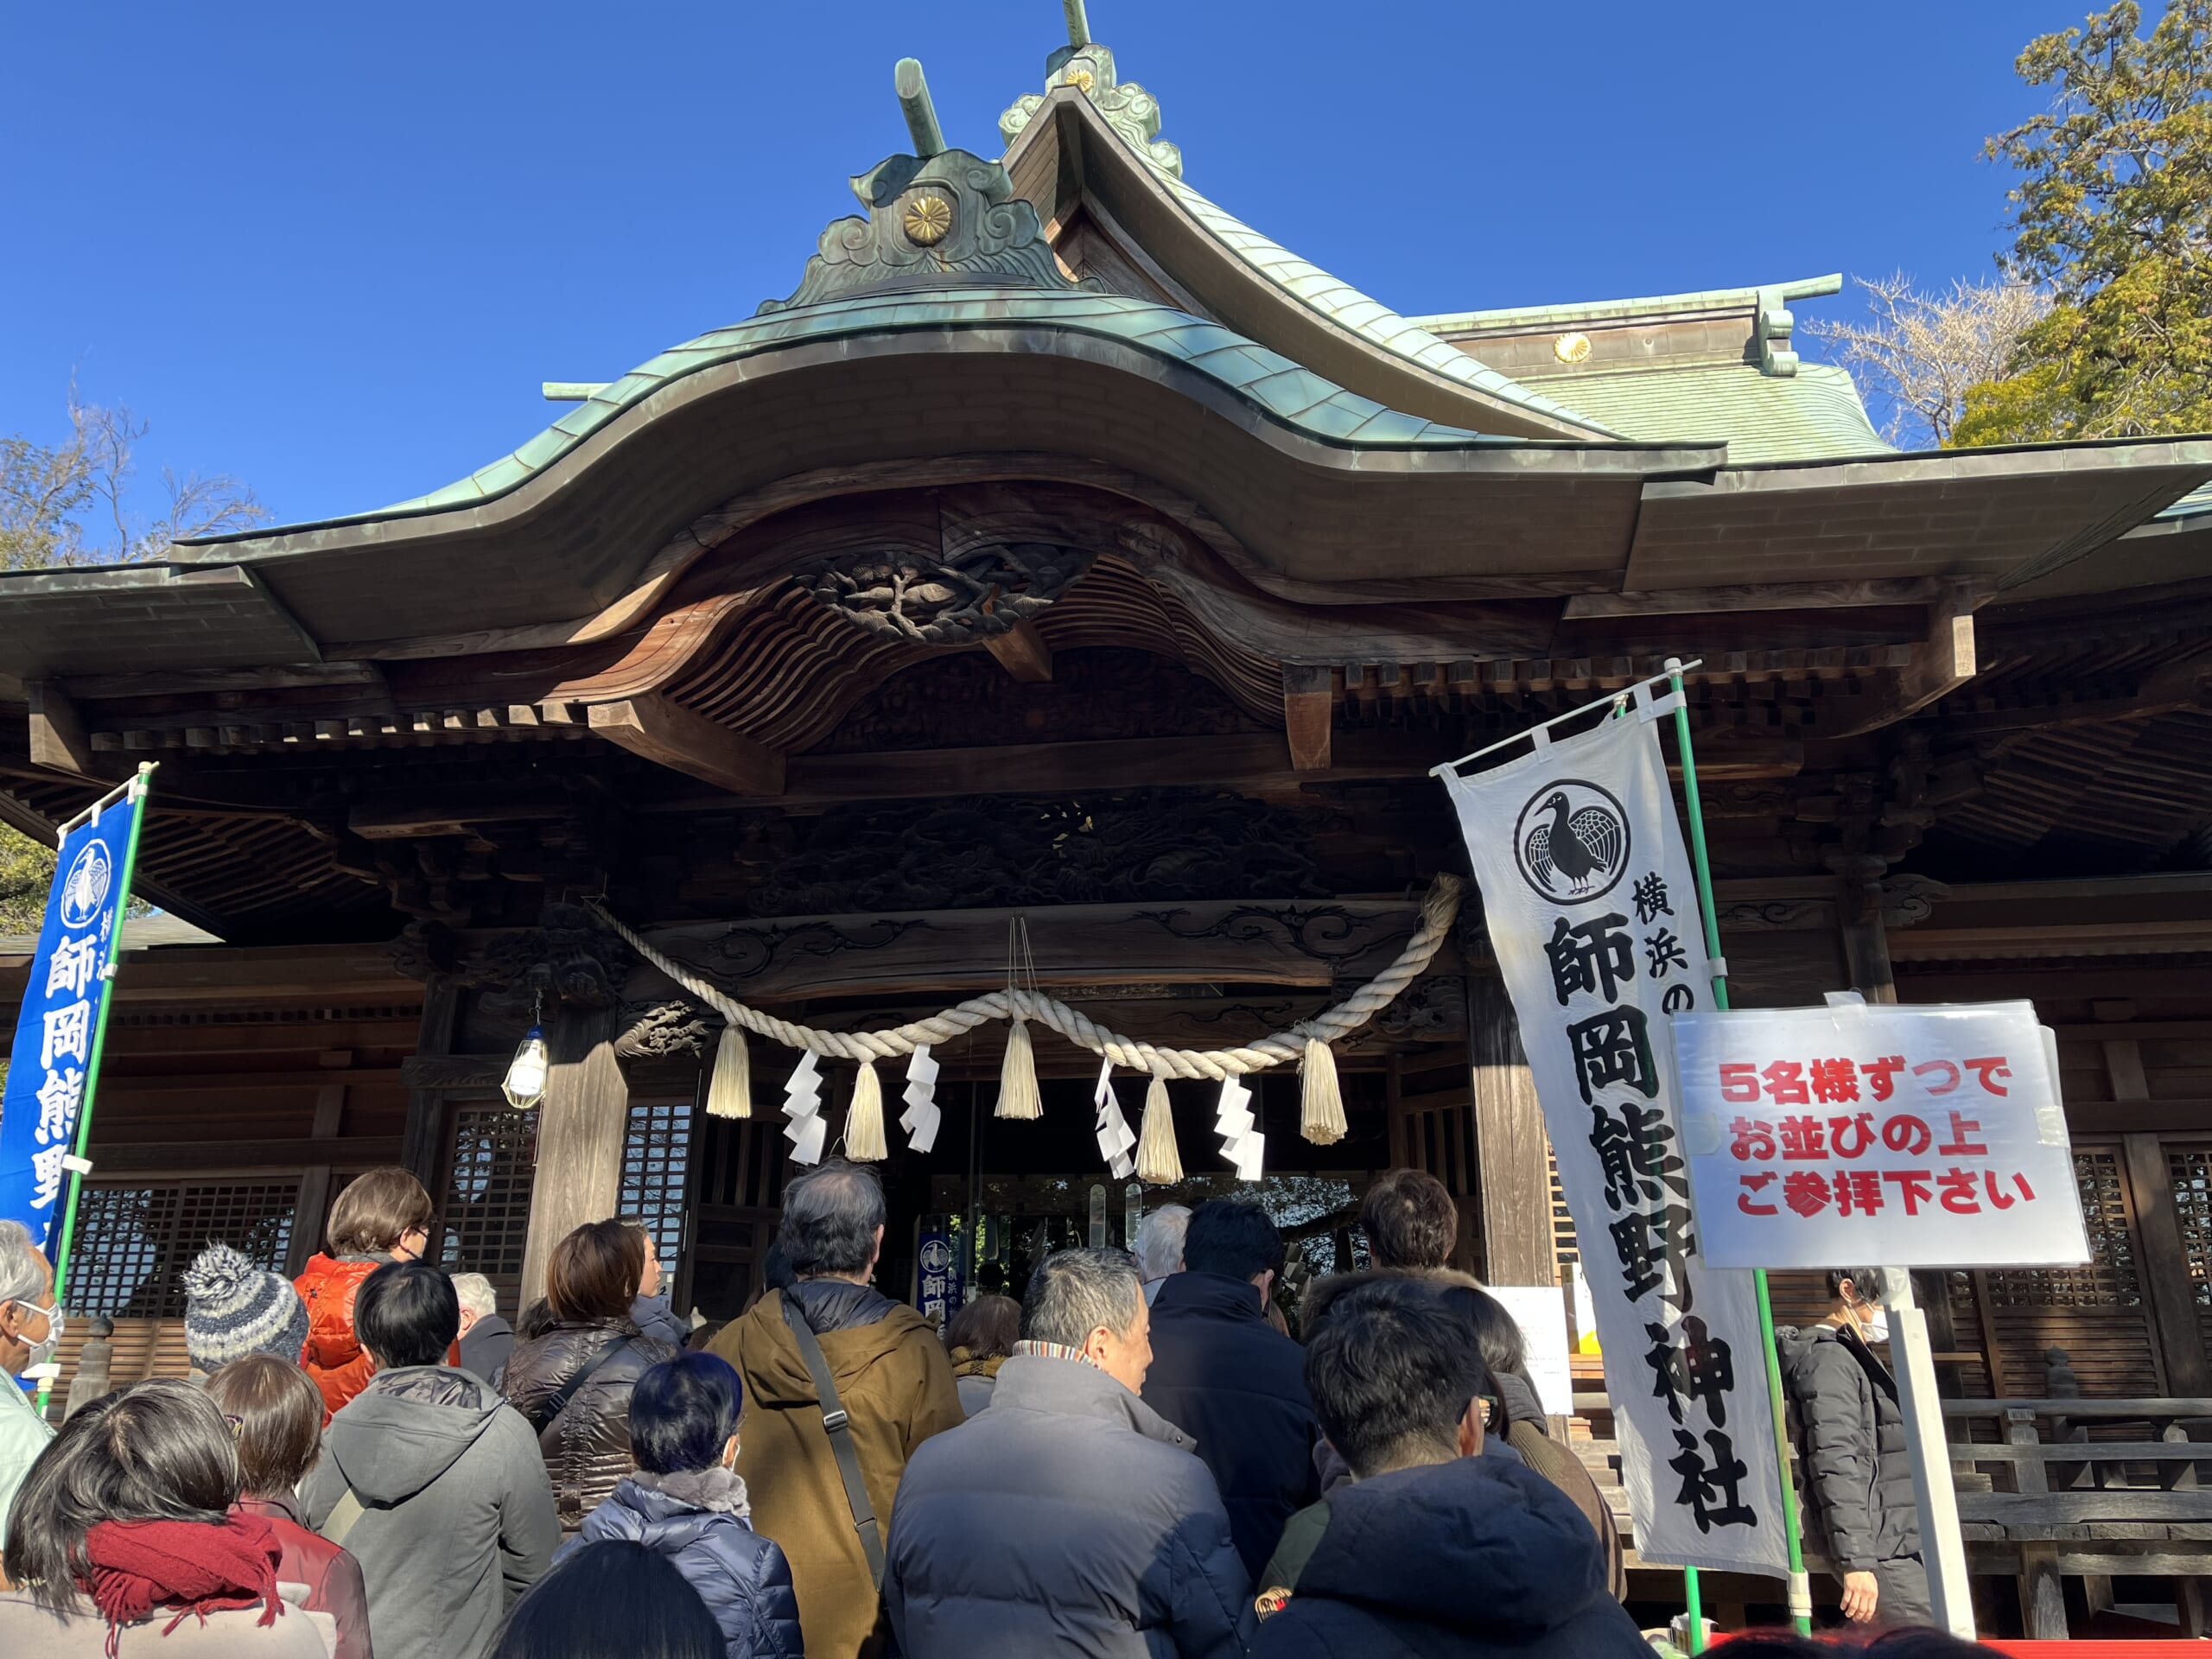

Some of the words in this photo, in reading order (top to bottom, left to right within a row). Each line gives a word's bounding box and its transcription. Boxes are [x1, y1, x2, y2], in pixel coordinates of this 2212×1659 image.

[1631, 871, 1694, 1014] 横浜の
[1719, 1055, 2013, 1105] 5名様ずつで
[1729, 1110, 1988, 1160] お並びの上
[1737, 1167, 2037, 1218] ご参拝下さい
[1543, 912, 1758, 1535] 師岡熊野神社
